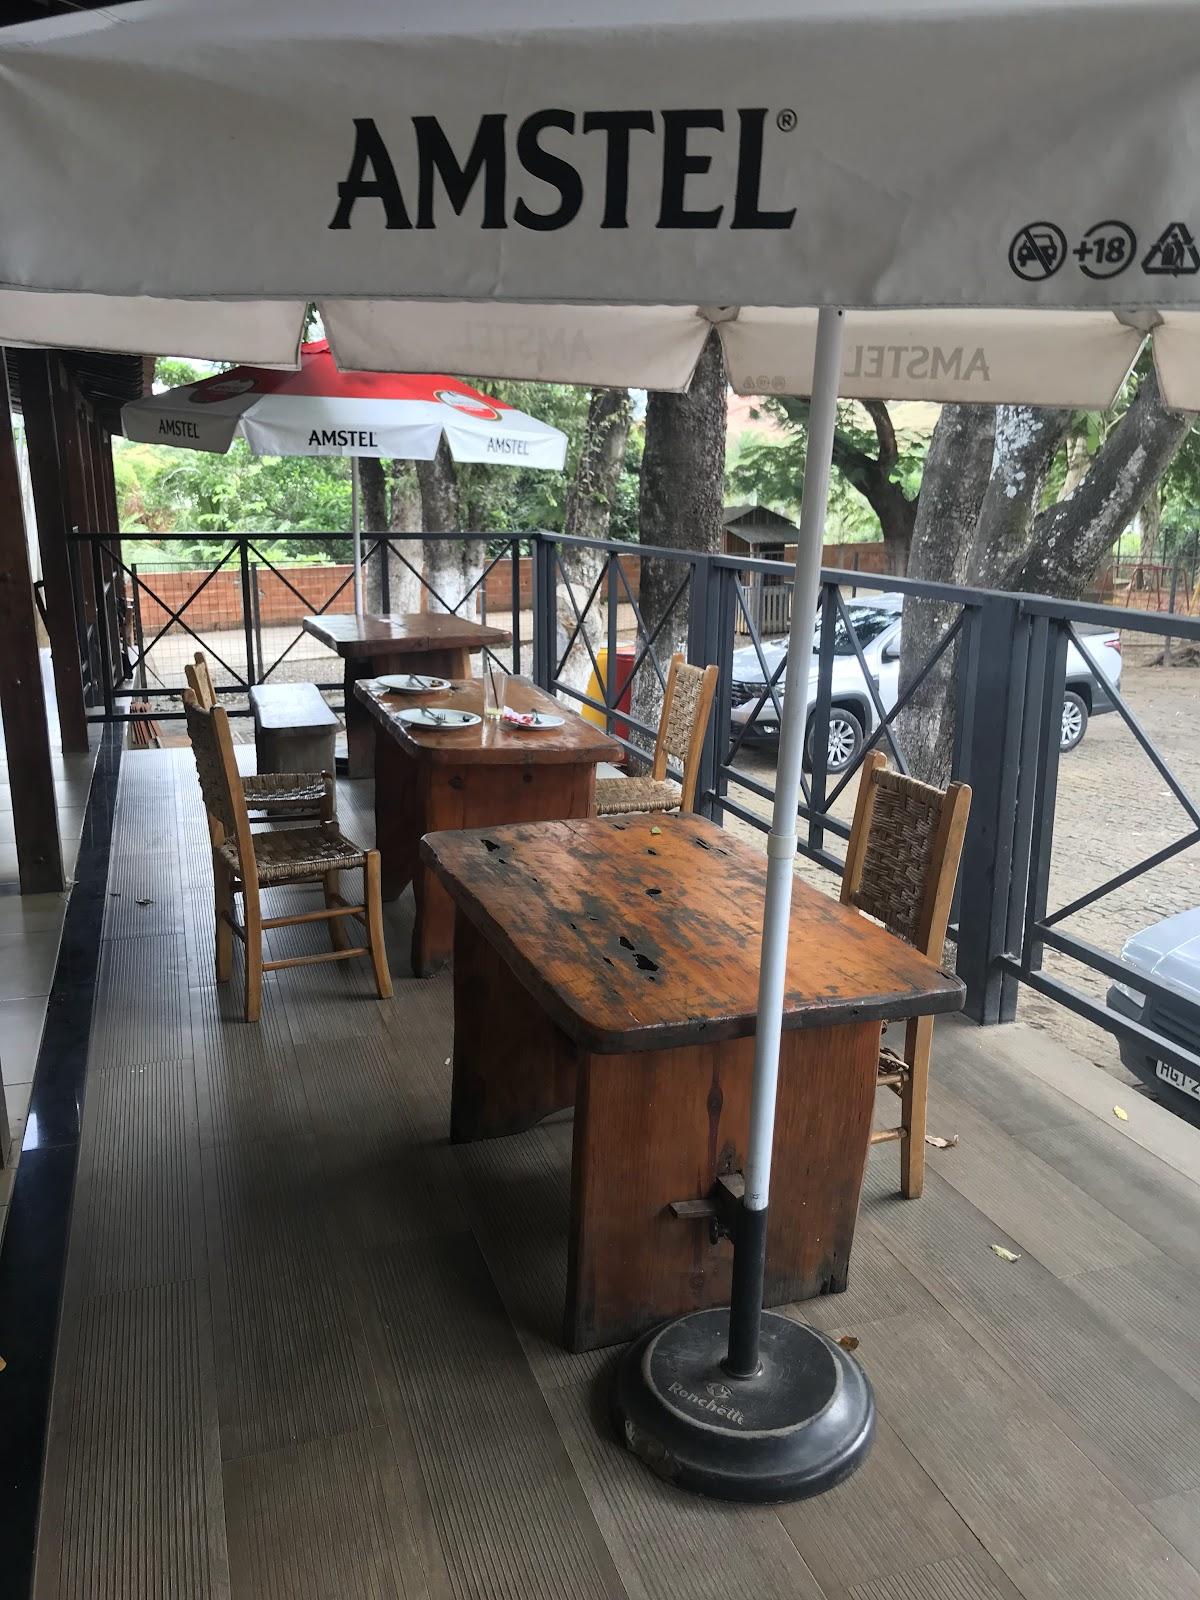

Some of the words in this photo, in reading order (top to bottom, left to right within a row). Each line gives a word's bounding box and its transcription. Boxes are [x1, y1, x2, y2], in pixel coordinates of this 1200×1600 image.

[1073, 236, 1125, 264] +18
[158, 418, 200, 439] AMSTEL
[308, 429, 378, 448] AMSTEL
[487, 436, 530, 456] AMSTEL
